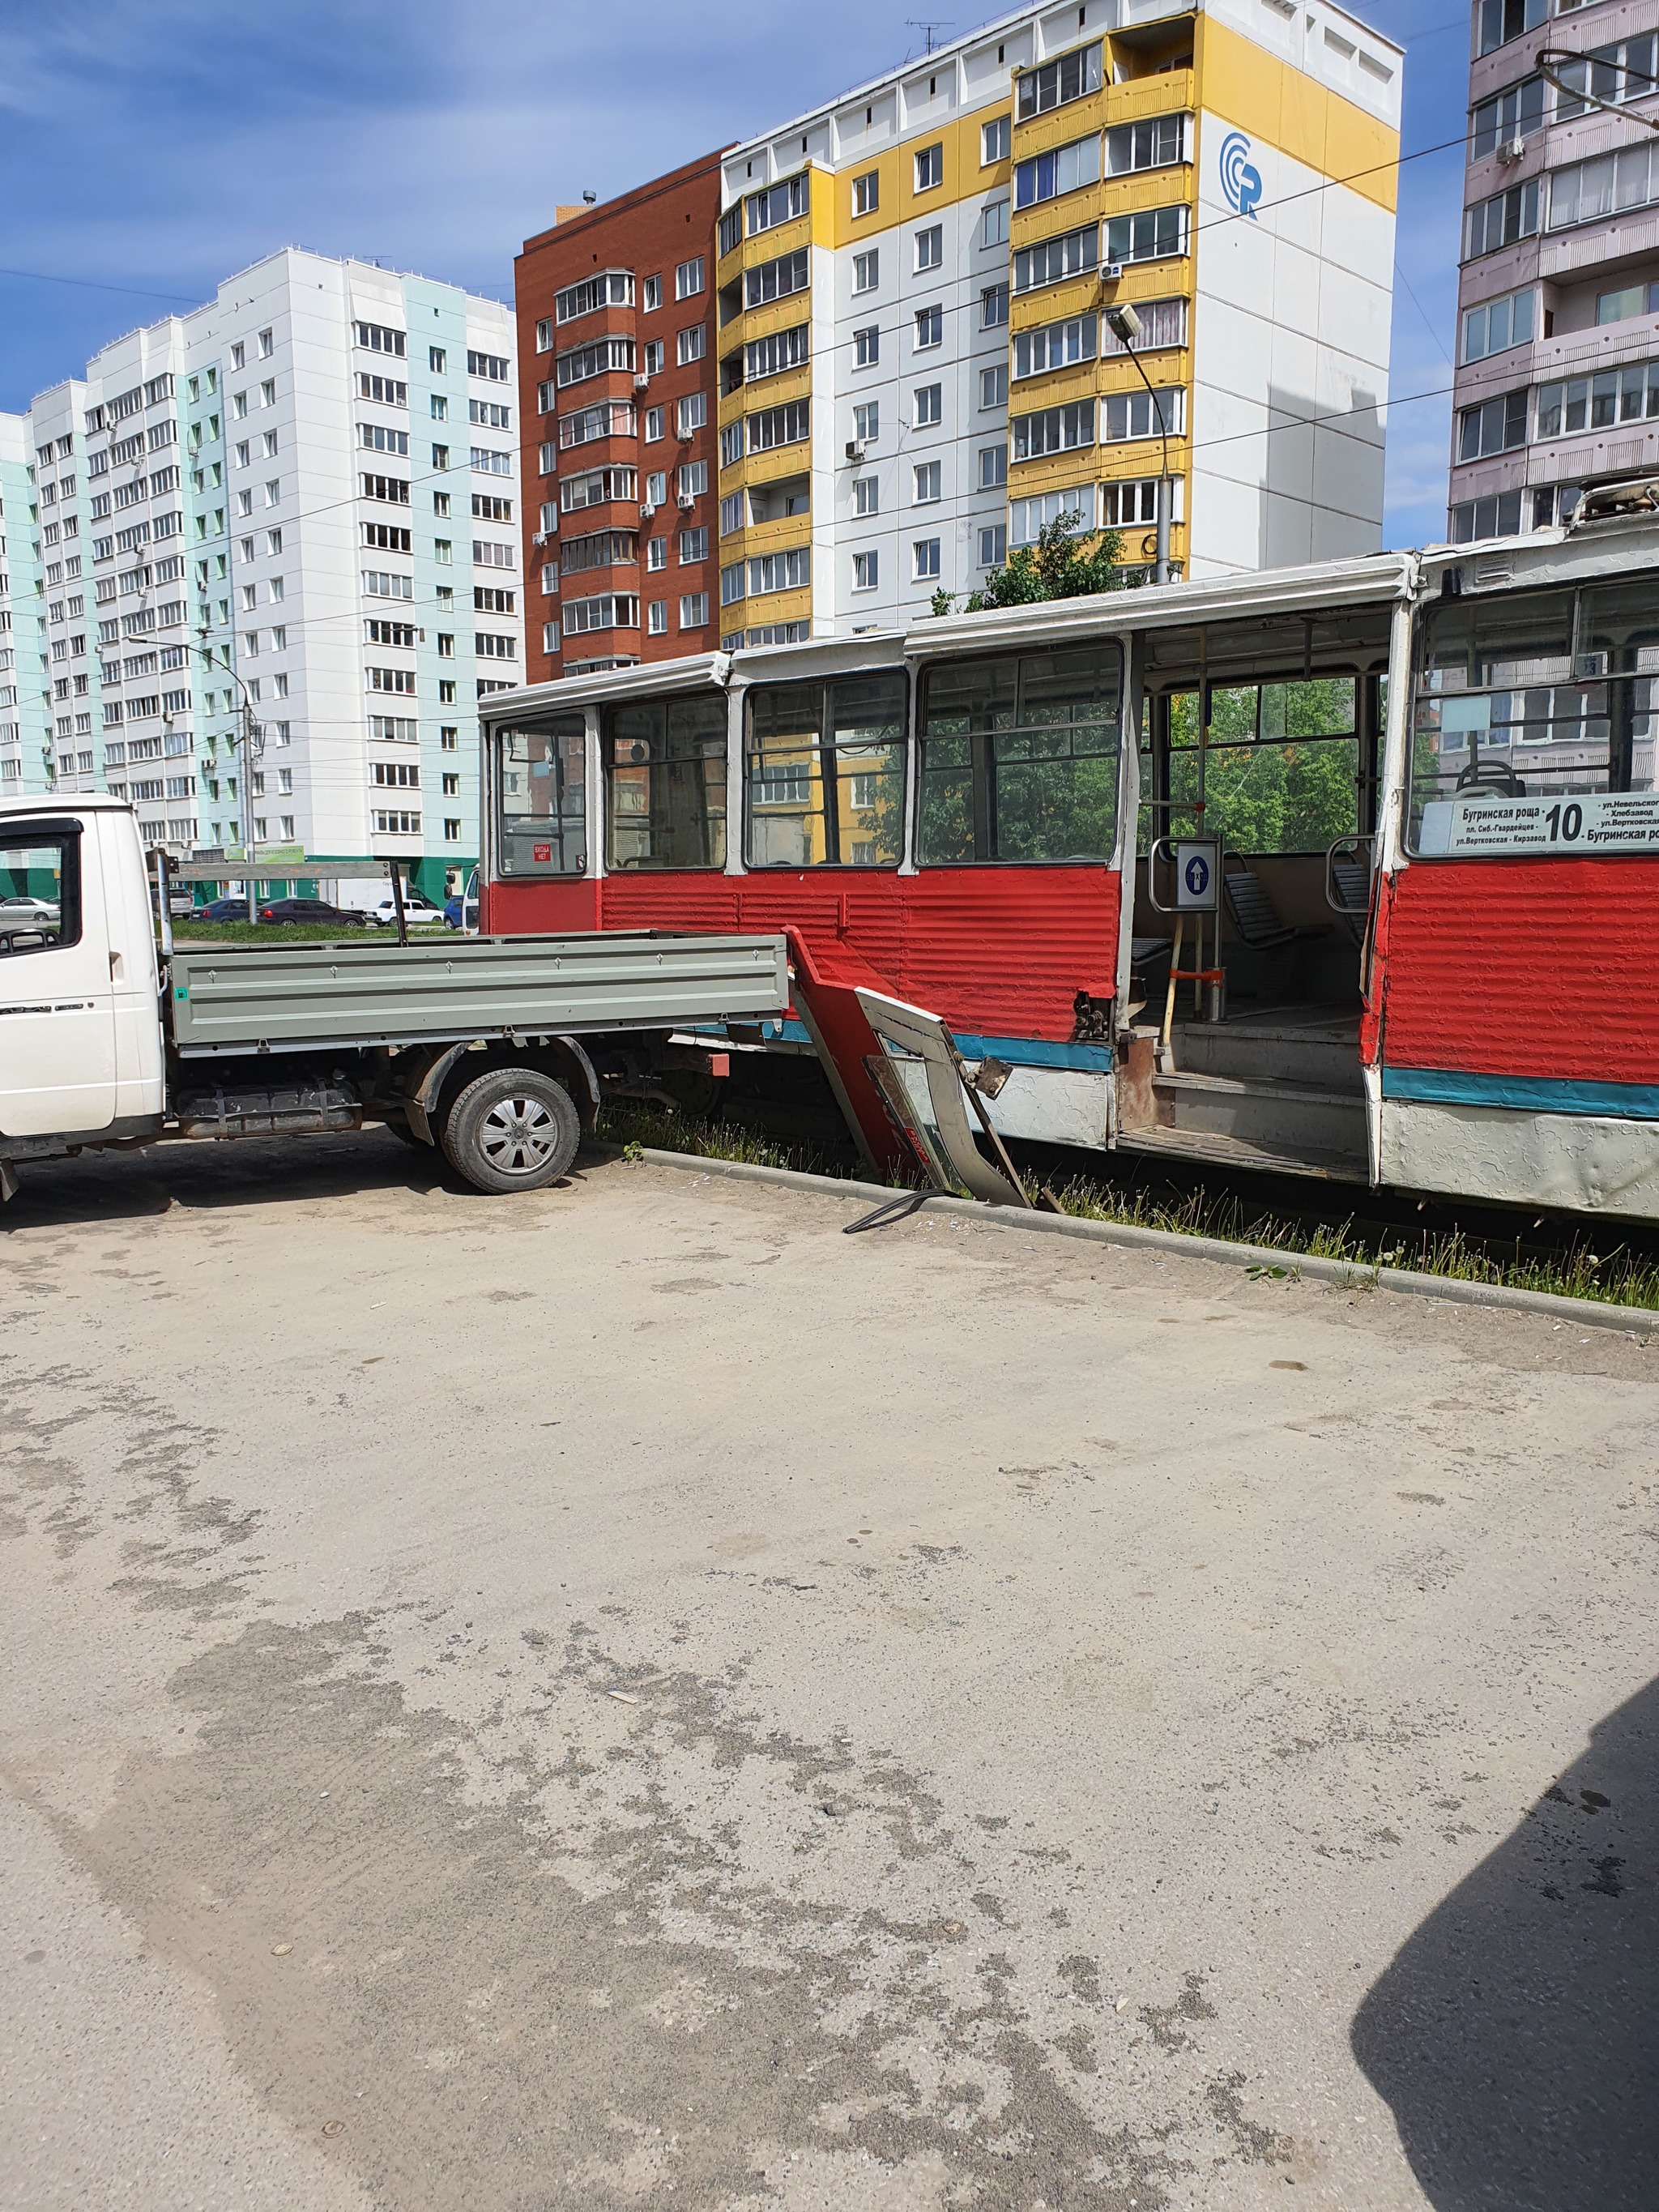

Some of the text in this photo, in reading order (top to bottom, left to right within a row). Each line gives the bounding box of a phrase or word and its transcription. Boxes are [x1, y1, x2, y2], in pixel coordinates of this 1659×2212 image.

[1462, 809, 1514, 823] Бугринская
[1516, 807, 1540, 821] роща
[1545, 803, 1583, 842] 10
[1456, 836, 1508, 846] ул.Вертковская
[1513, 835, 1546, 843] Кирзавод
[1588, 830, 1646, 843] Бугринская
